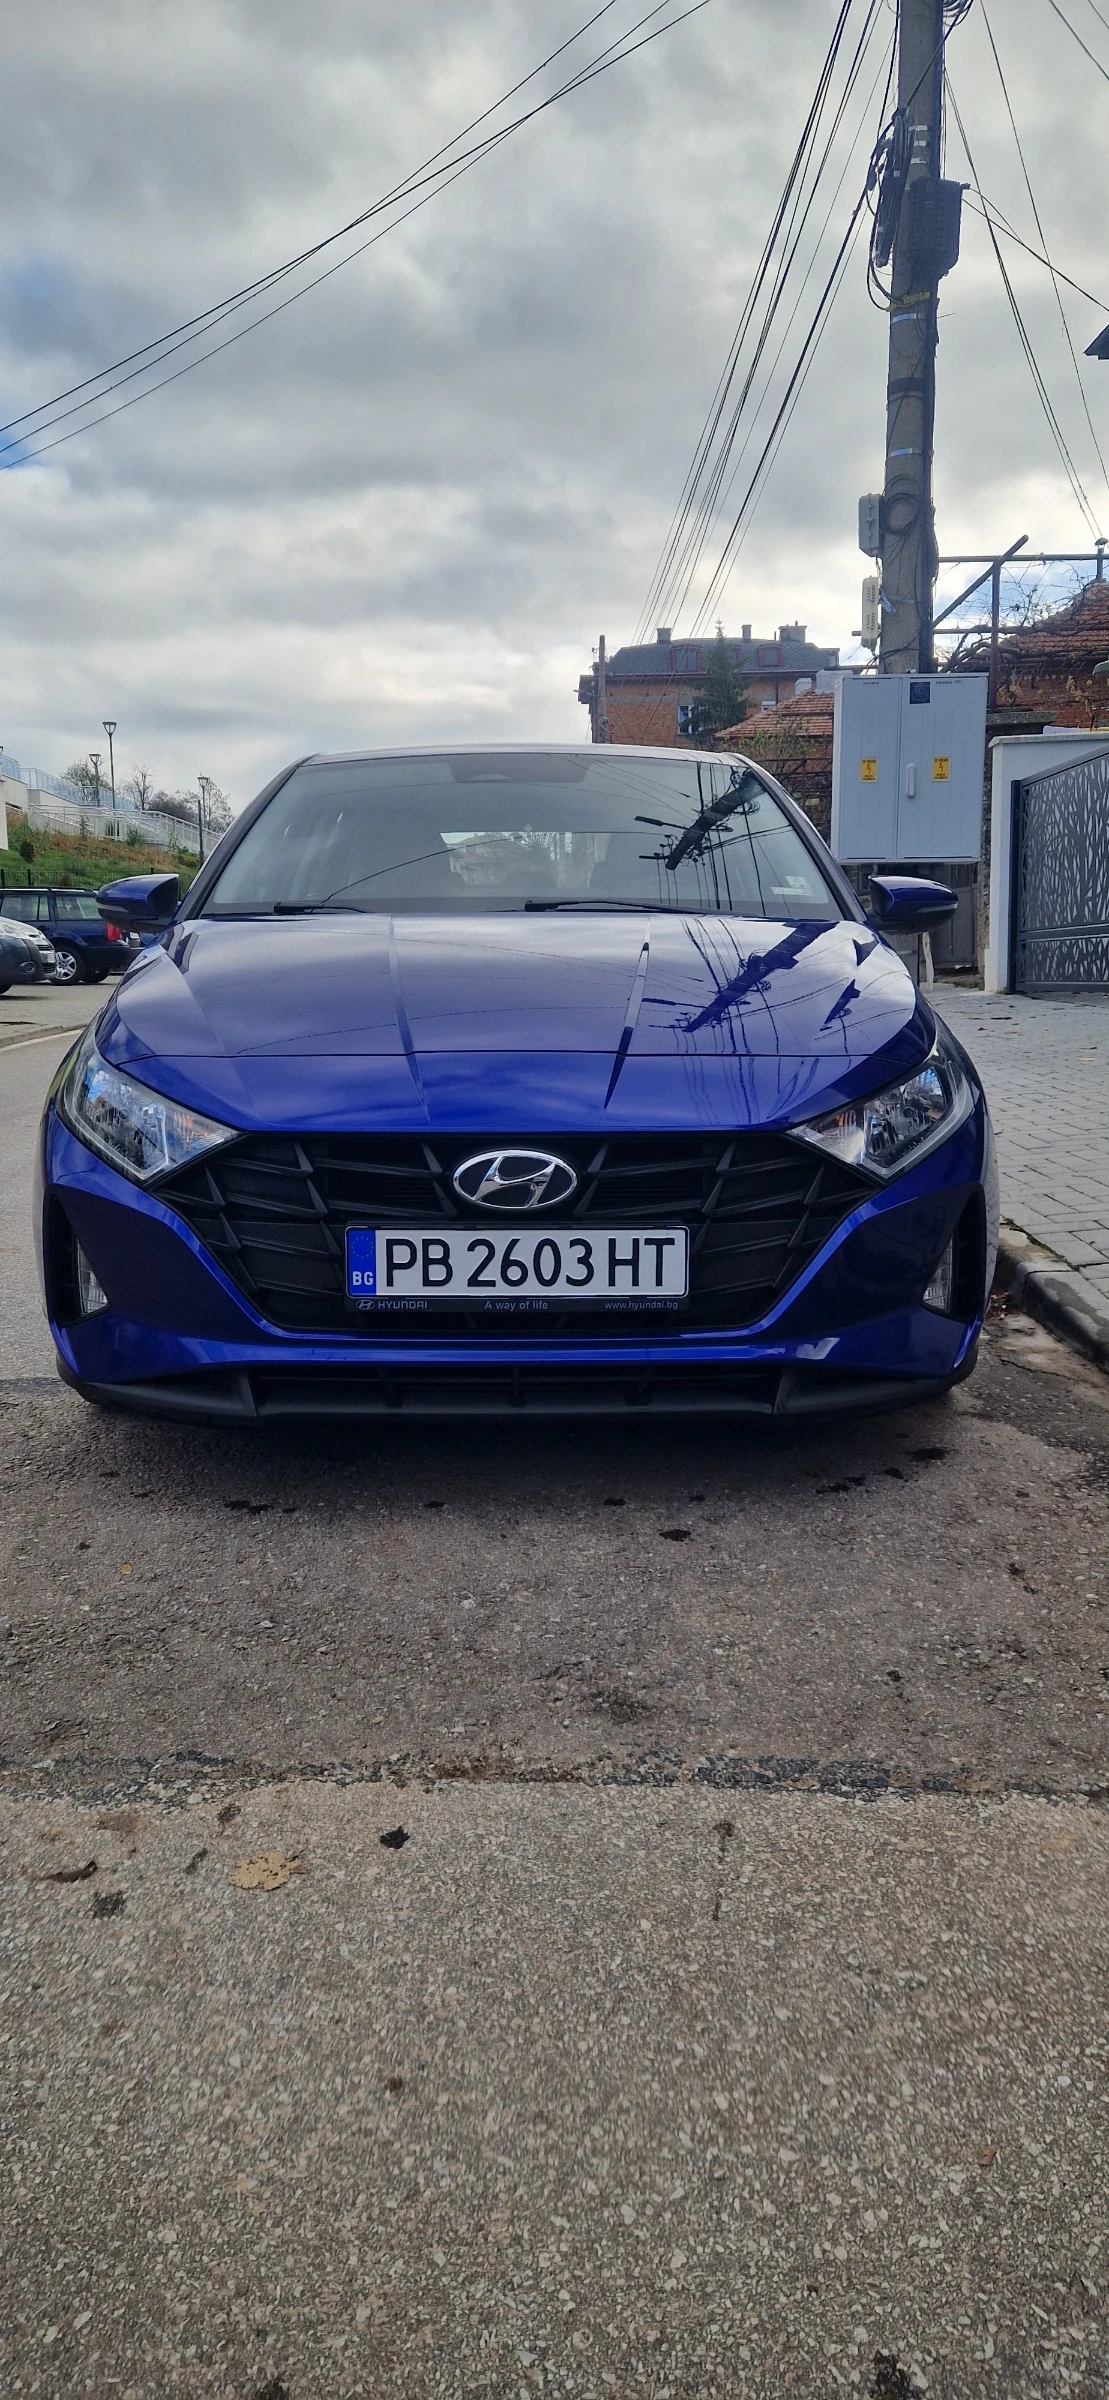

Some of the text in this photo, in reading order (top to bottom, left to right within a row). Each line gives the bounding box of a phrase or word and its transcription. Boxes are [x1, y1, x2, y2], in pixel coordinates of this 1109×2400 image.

[385, 1237, 676, 1288] PB 2603 HT
[352, 1271, 374, 1286] BG
[377, 1301, 428, 1309] HYUNDAI
[484, 1301, 549, 1312] A way of life
[604, 1301, 679, 1311] www.hyundai.bg
